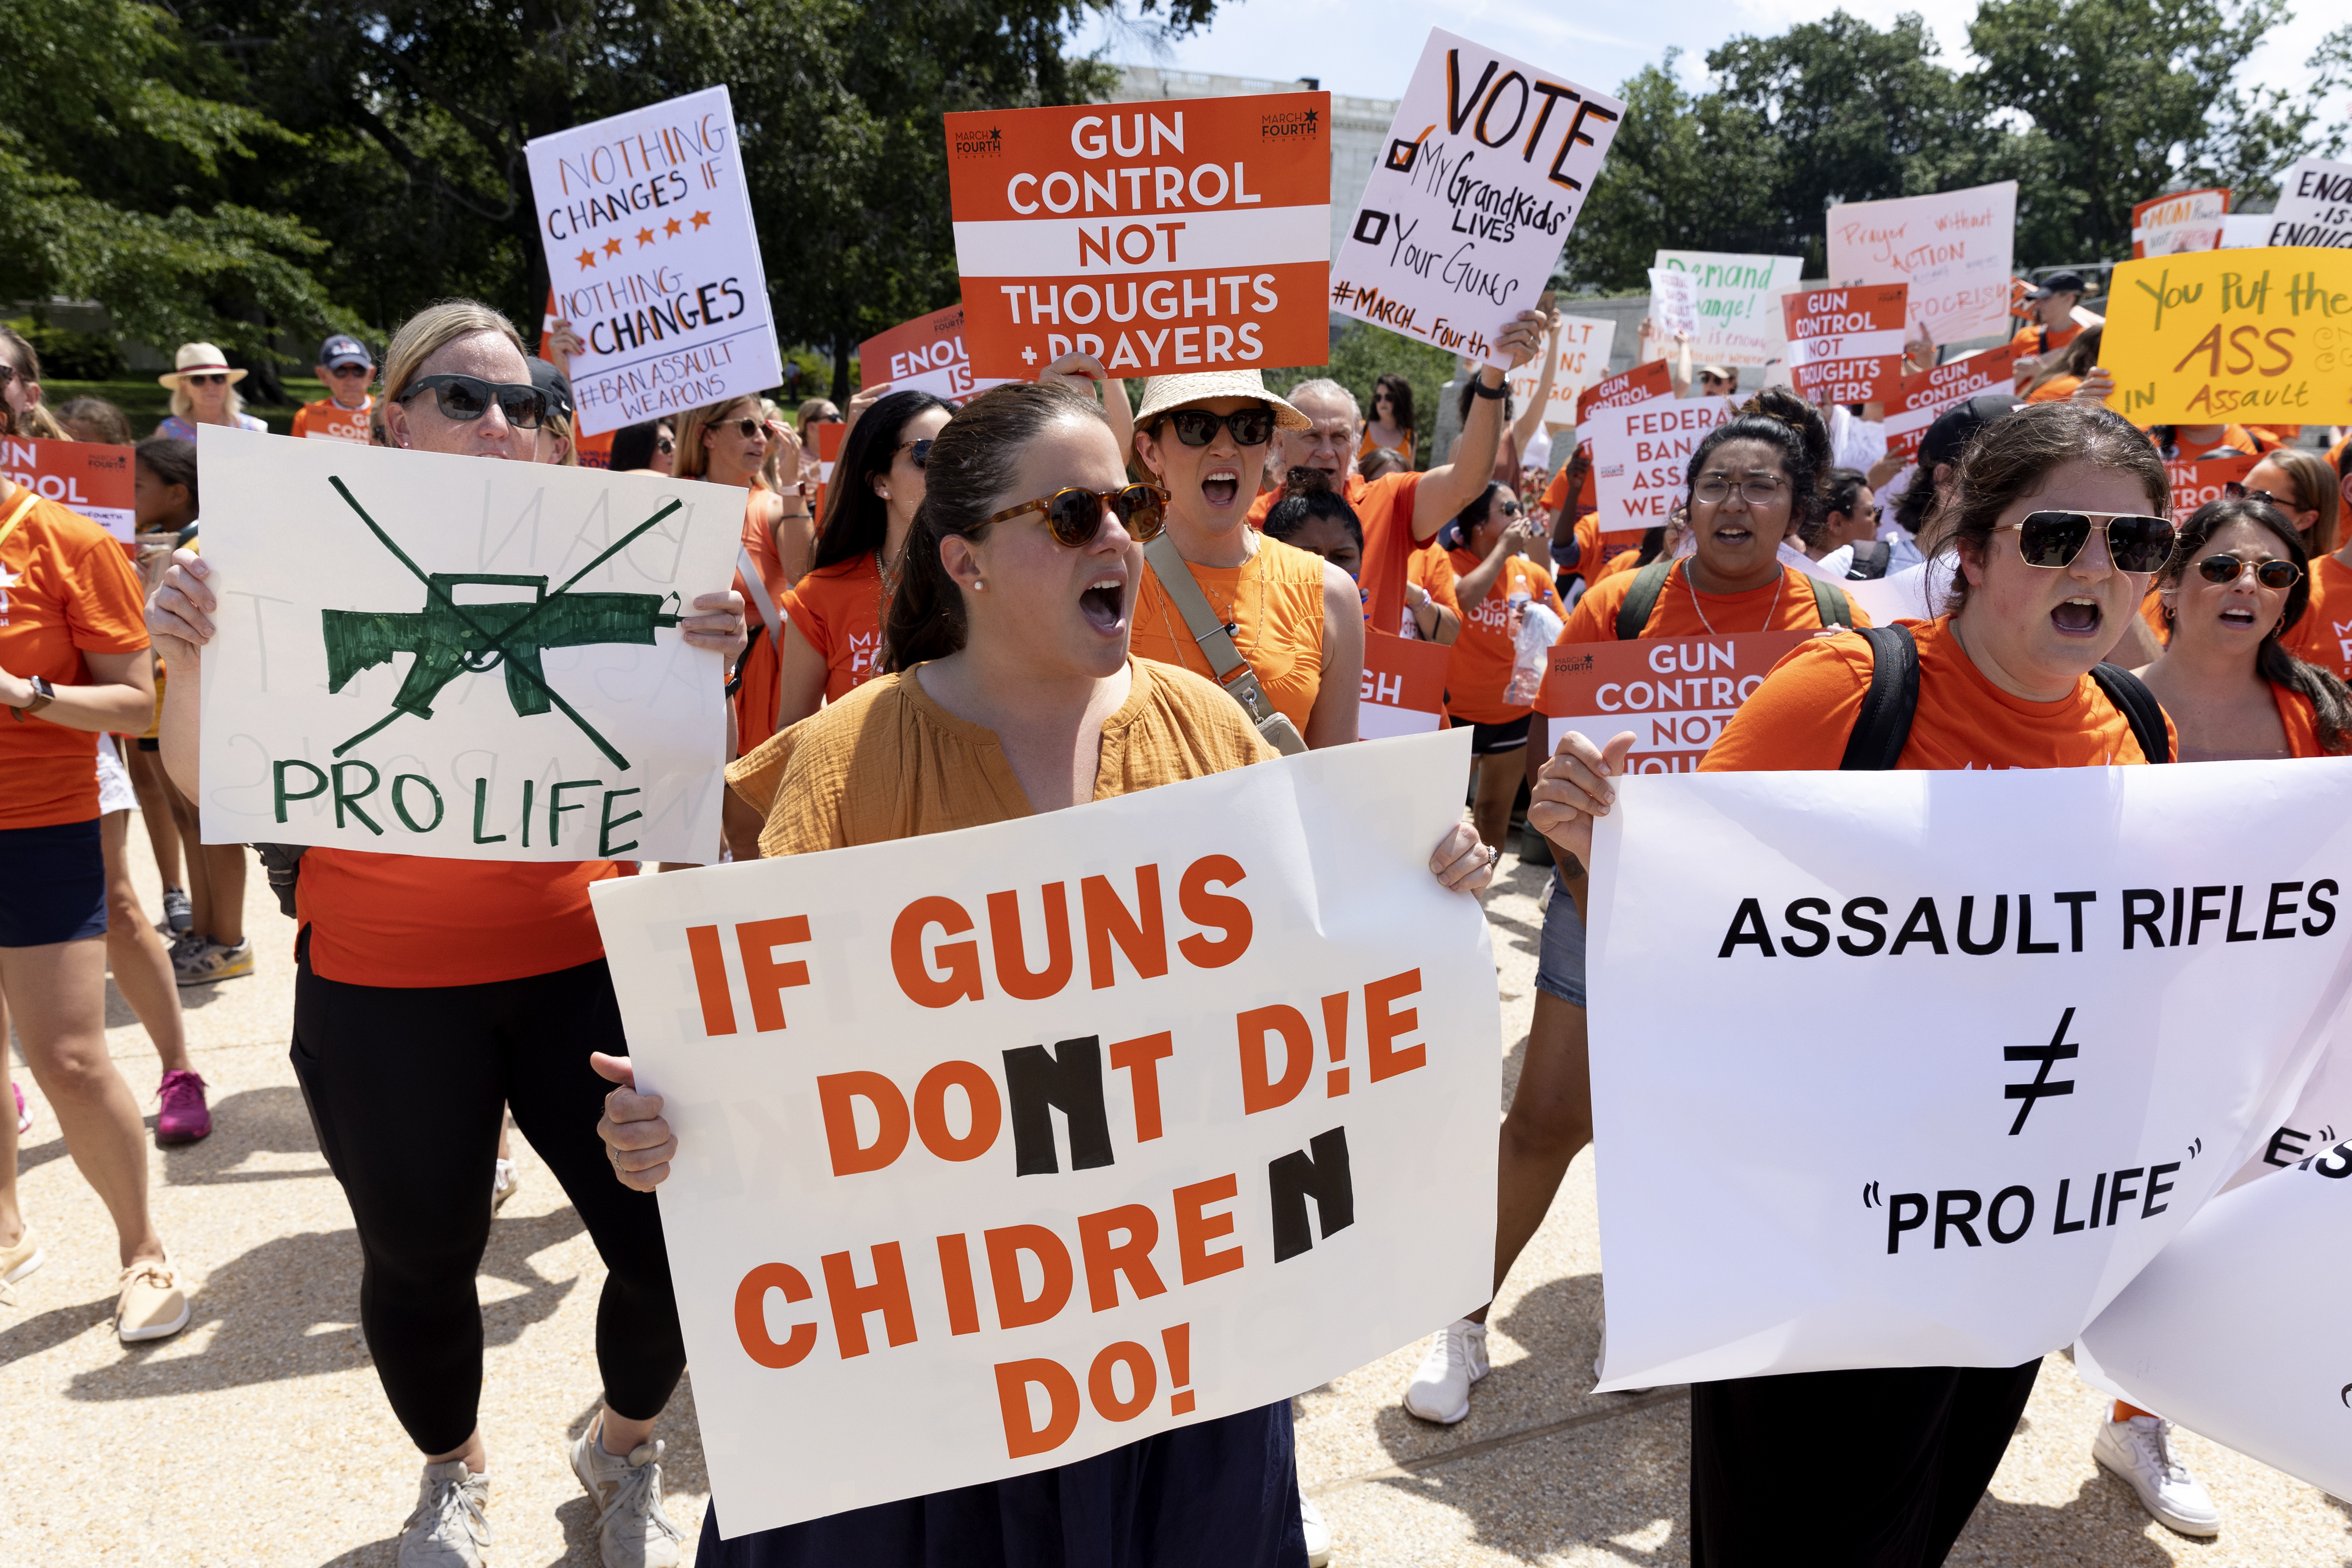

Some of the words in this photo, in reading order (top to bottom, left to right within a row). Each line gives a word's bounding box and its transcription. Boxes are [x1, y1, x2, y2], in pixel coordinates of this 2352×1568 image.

[955, 131, 988, 140] MARCH
[1071, 111, 1184, 159] GUN
[1262, 113, 1301, 123] MARCH
[1263, 123, 1316, 136] FOURTH
[1446, 49, 1618, 191] VOTE
[560, 113, 727, 195] NOTHING
[956, 141, 1000, 153] FOURTH
[548, 171, 688, 239] CHANGES
[701, 156, 724, 190] IF
[1007, 162, 1261, 215] CONTROL
[1452, 209, 1515, 243] LIVES
[1078, 222, 1186, 267] NOT
[1891, 241, 1965, 274] ACTION
[561, 266, 683, 320] NOTHING
[1001, 273, 1278, 325] THOUGHTS
[1807, 291, 1848, 314] GUN
[2136, 269, 2203, 331] You
[591, 277, 745, 354] CHANGES
[1796, 311, 1877, 338] CONTROL
[1048, 322, 1264, 370] PRAYERS
[1808, 338, 1843, 359] NOT
[2173, 323, 2296, 377] ASS
[948, 366, 975, 394] IS
[1599, 374, 1630, 397] GUN
[1798, 359, 1880, 387] THOUGHTS
[1906, 372, 1993, 410] CONTROL
[1929, 361, 1969, 386] GUN
[621, 373, 726, 419] WEAPONS
[1584, 385, 1652, 420] CONTROL
[2125, 383, 2156, 413] IN
[1627, 408, 1734, 436] FEDERA
[1637, 437, 1691, 462] BAN
[1555, 663, 1592, 672] FOURTH
[1649, 641, 1735, 673] GUN
[272, 759, 445, 835] PRO
[474, 778, 642, 857] LIFE
[1717, 890, 2097, 958] ASSAULT
[2122, 878, 2339, 950] RIFLES
[686, 914, 811, 1036] IF
[890, 854, 1253, 1008] GUNS
[816, 1030, 1174, 1177] DONT
[1236, 967, 1427, 1116] D!E
[994, 1322, 1196, 1460] DO!
